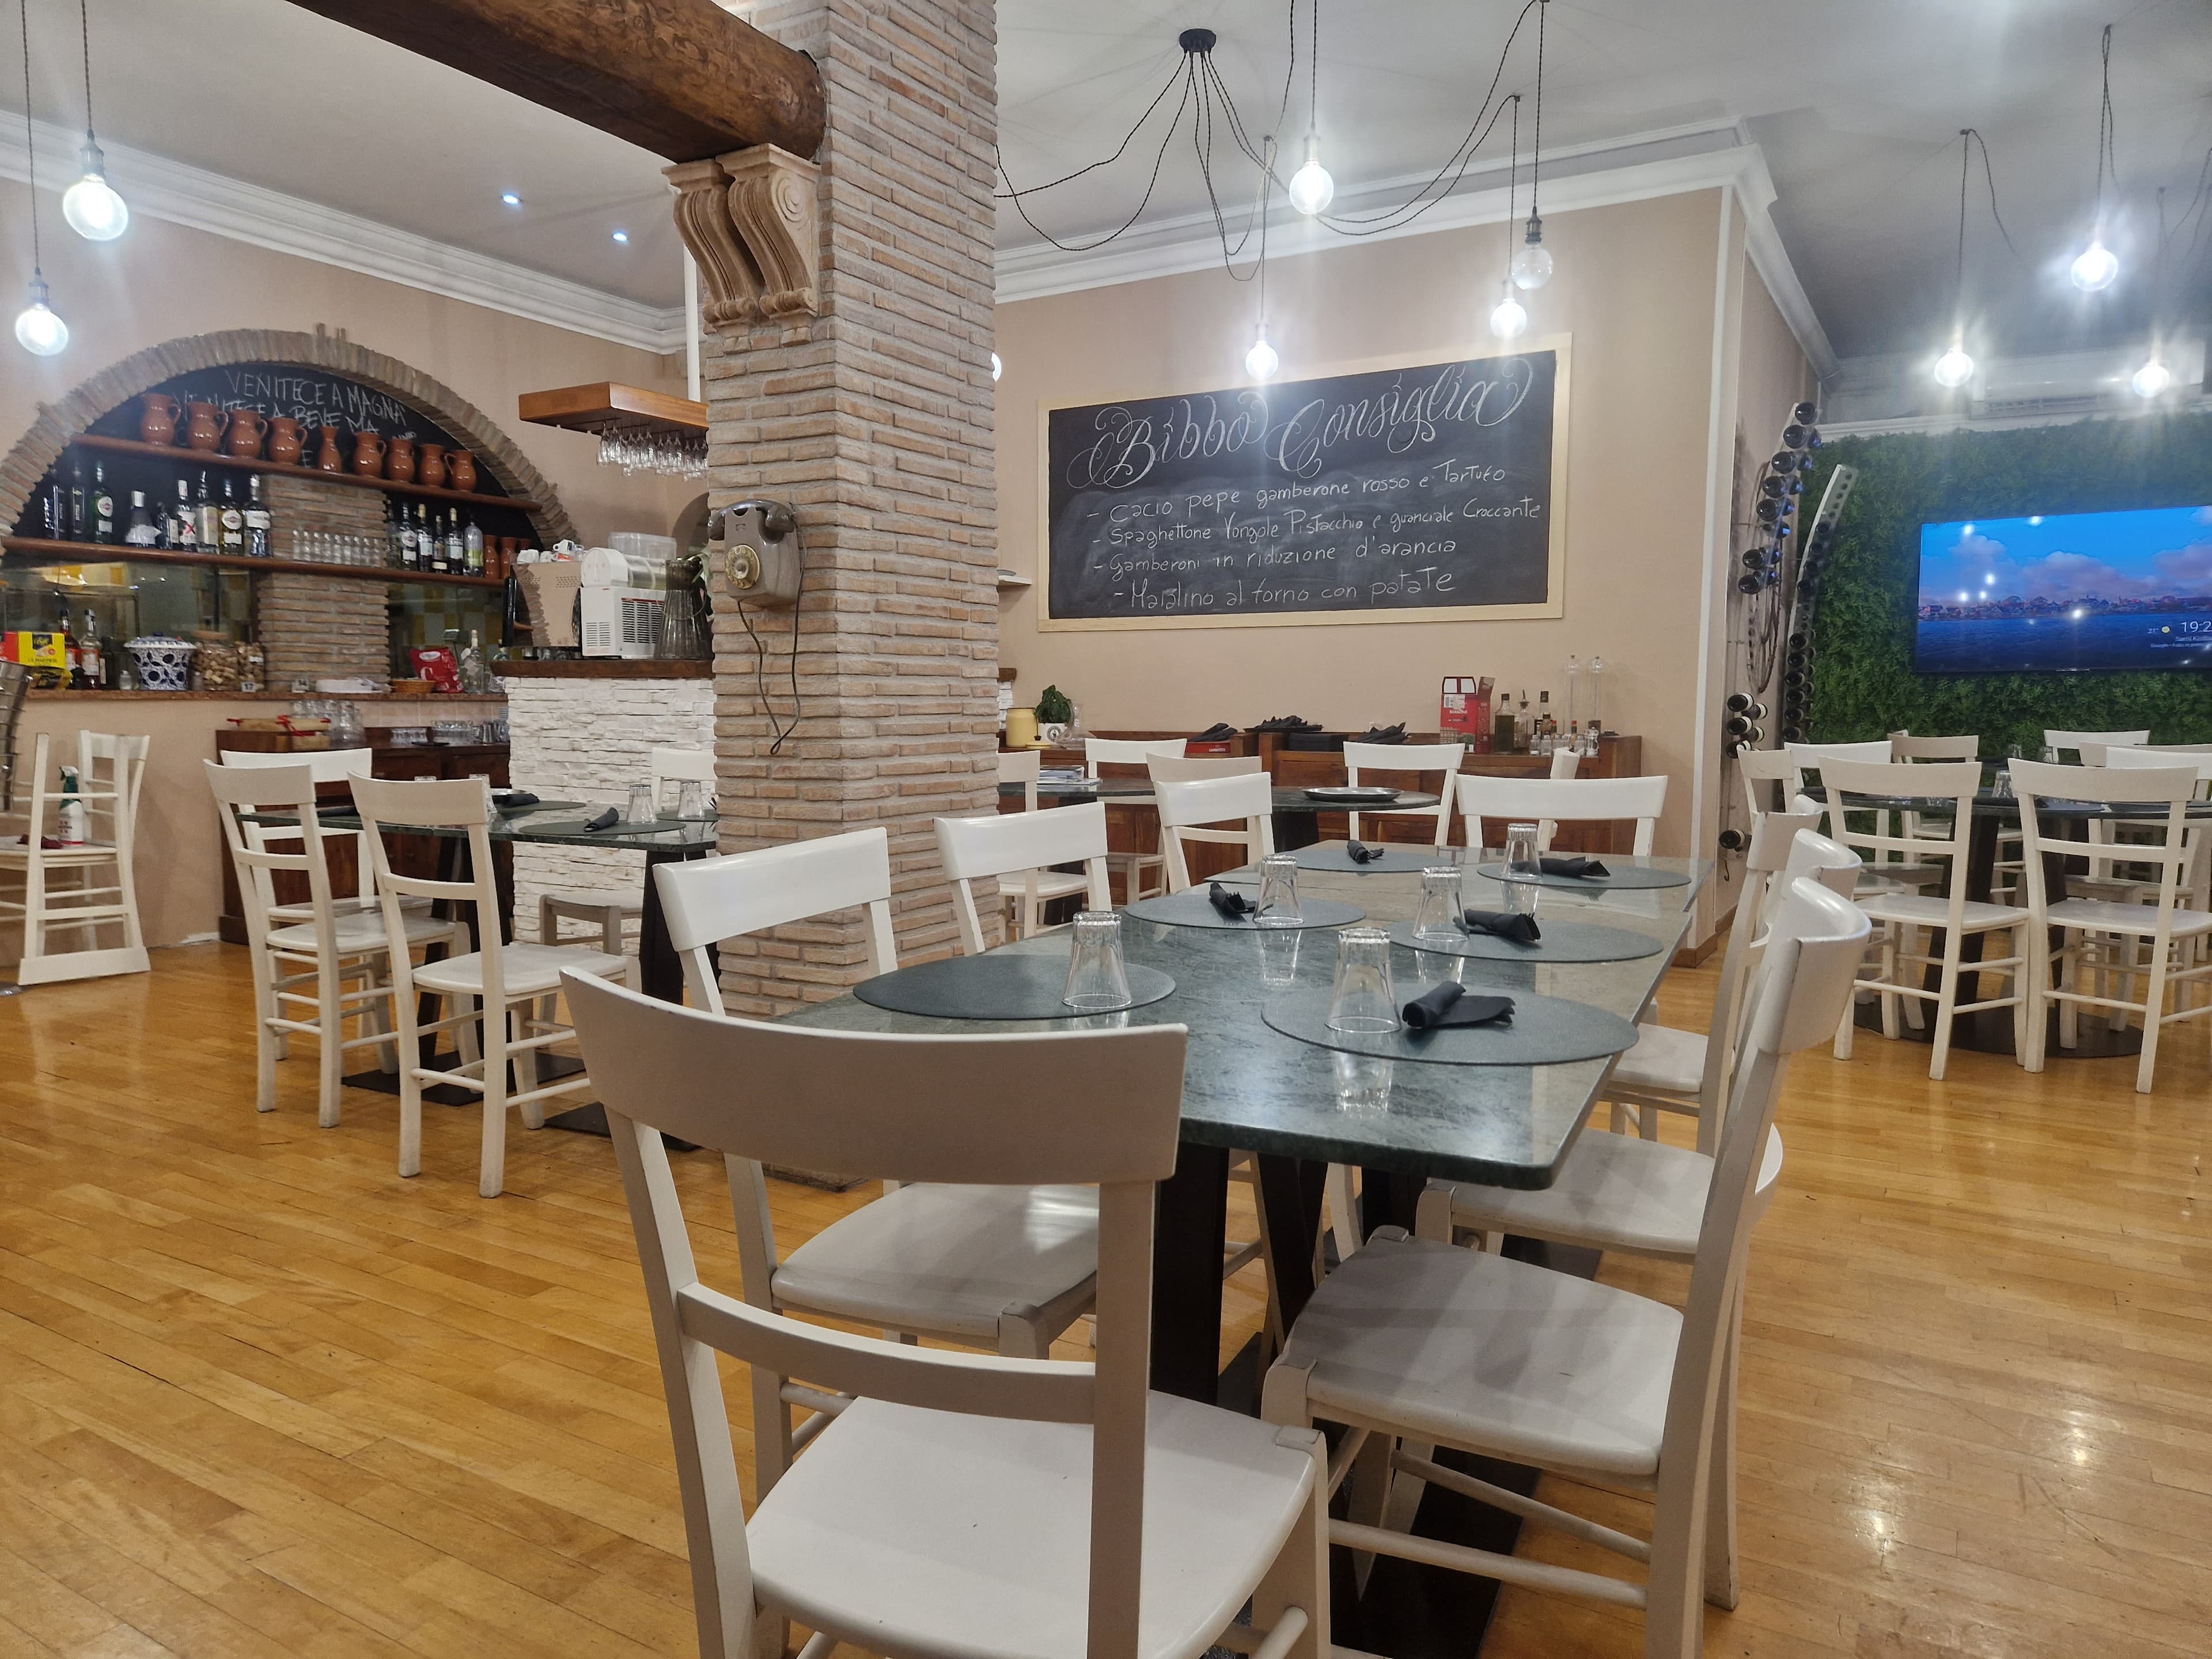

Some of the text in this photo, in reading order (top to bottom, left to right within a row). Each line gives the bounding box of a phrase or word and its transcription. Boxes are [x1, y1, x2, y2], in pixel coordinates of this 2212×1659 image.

[225, 369, 328, 405] VENITECE
[332, 382, 344, 409] A
[1264, 358, 1534, 479] Consiglia
[1110, 501, 1173, 522] Cacio
[1185, 490, 1240, 518] pepe
[1256, 480, 1350, 509] gamberone
[1362, 478, 1410, 493] rosso
[1109, 522, 1211, 548] Spaghettone
[1224, 511, 1279, 544] Vongole
[1373, 514, 1381, 529] e
[1390, 505, 1453, 532] guanciale
[1463, 495, 1541, 518] Croccante
[1212, 554, 1233, 567] in
[1247, 544, 1336, 567] riduzione
[1226, 579, 1243, 605] al
[1251, 577, 1309, 604] forno
[1321, 586, 1357, 599] con
